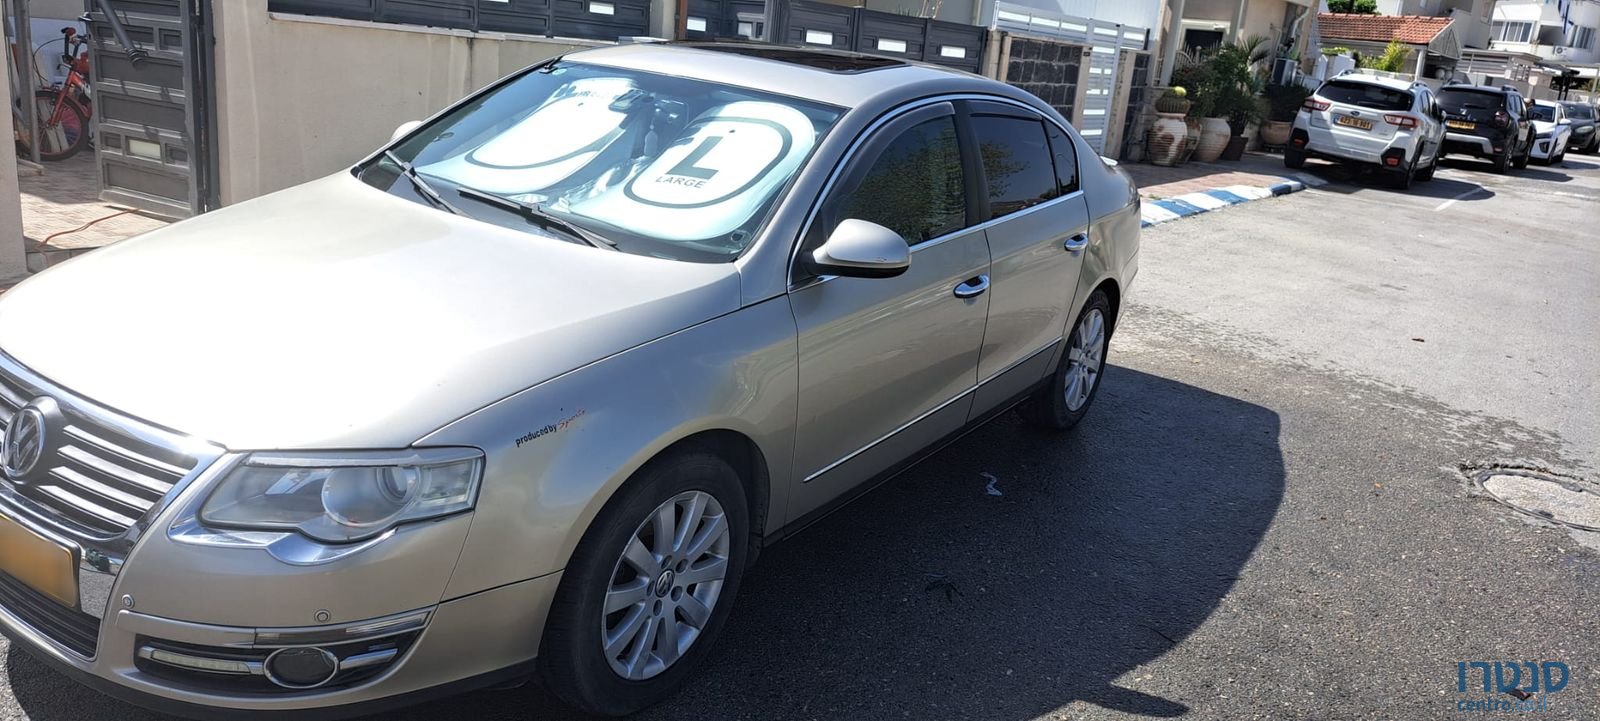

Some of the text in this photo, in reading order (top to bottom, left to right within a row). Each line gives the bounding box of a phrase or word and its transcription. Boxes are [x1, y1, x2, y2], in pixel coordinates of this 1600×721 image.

[664, 136, 724, 181] L
[655, 176, 707, 188] LARGE
[515, 426, 548, 447] produced
[548, 423, 557, 433] by
